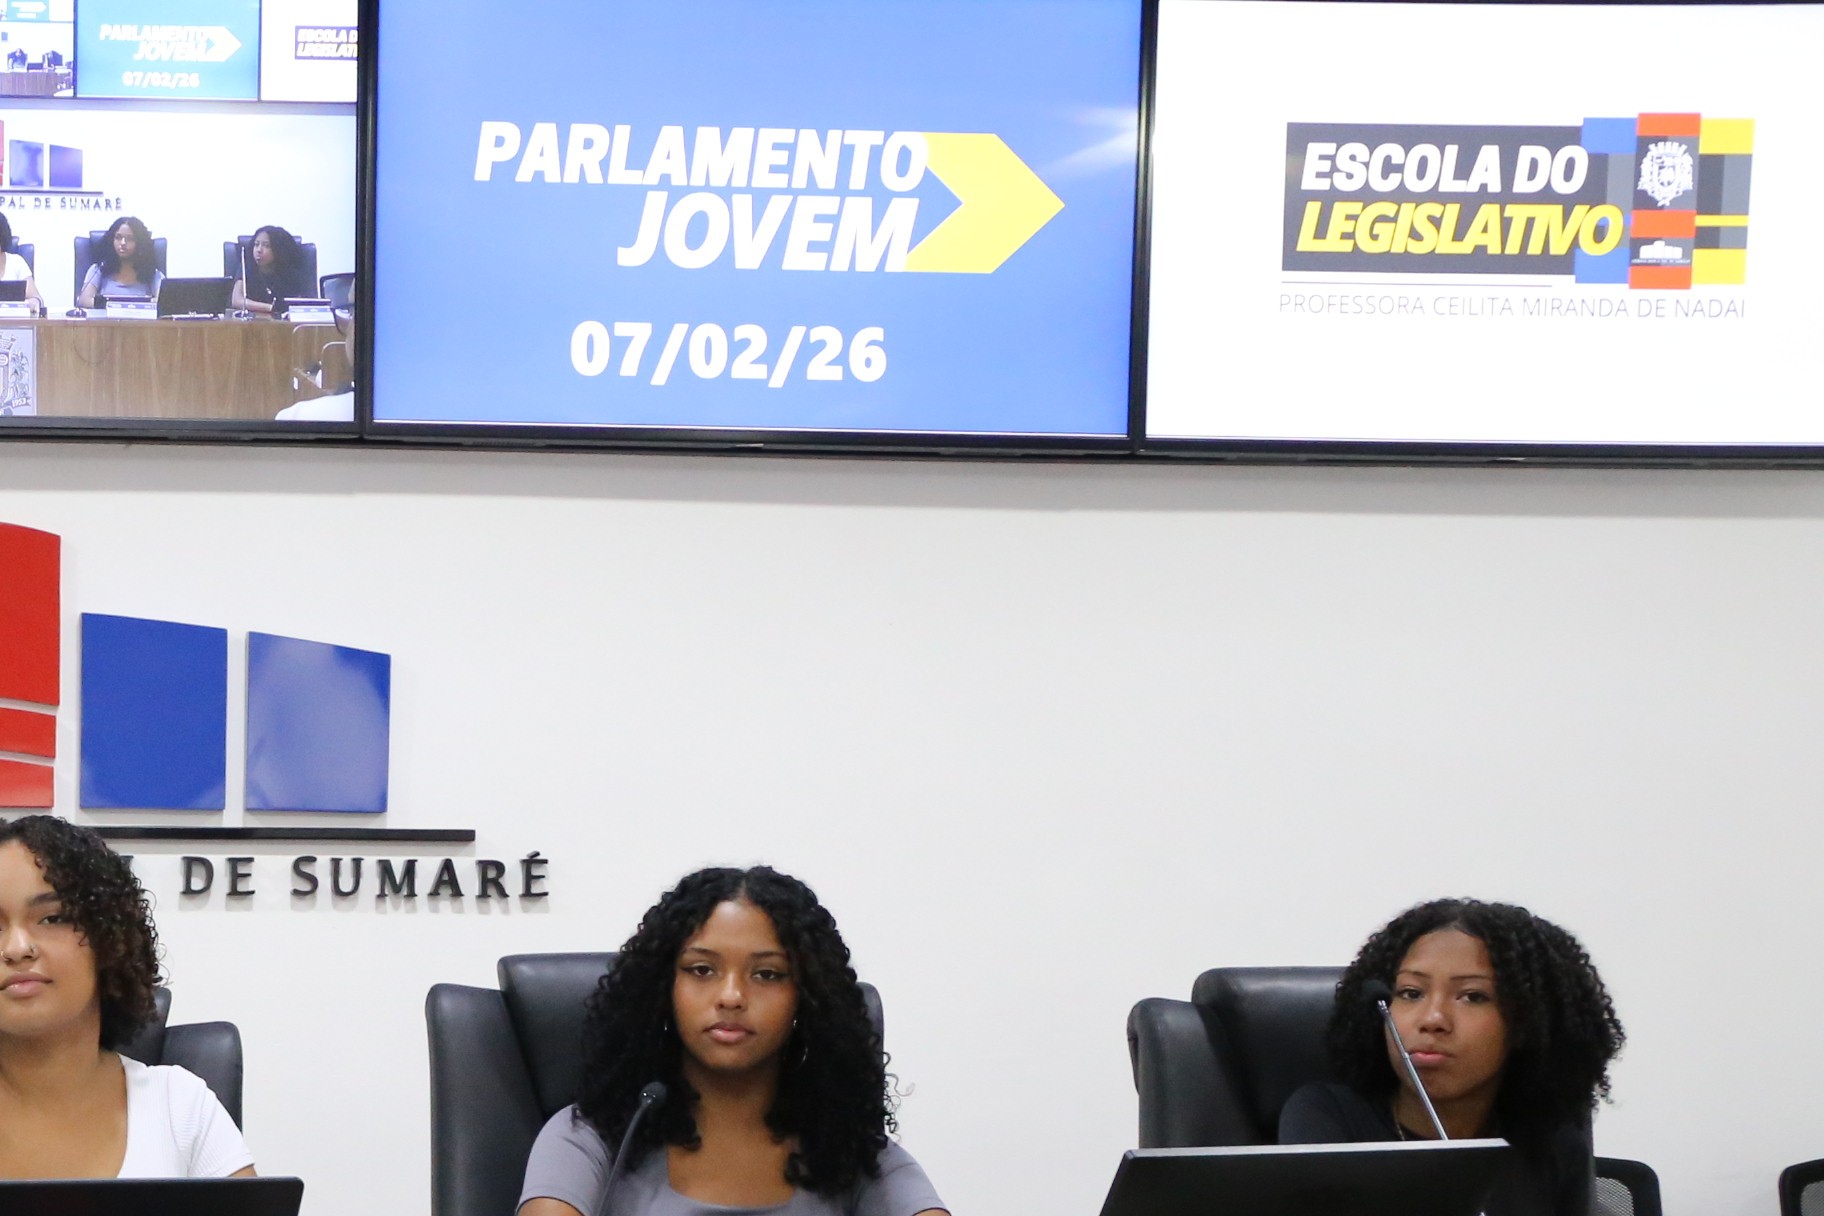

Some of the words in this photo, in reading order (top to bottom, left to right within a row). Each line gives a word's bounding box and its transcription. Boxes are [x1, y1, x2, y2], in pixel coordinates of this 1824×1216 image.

[474, 121, 928, 192] PARLAMENTO
[1300, 142, 1503, 194] ESCOLA
[1511, 145, 1589, 195] DO
[616, 190, 919, 273] JOVEM
[1296, 201, 1624, 256] LEGISLATIVO
[1279, 293, 1425, 315] PROFESSORA
[1433, 296, 1514, 316] CEILITA
[1522, 298, 1629, 317] MIRANDA
[1638, 299, 1666, 318] DE
[1676, 299, 1745, 318] NADAI
[570, 320, 887, 388] 07/02/26
[181, 855, 256, 896] DE
[291, 851, 549, 899] SUMARÉ
